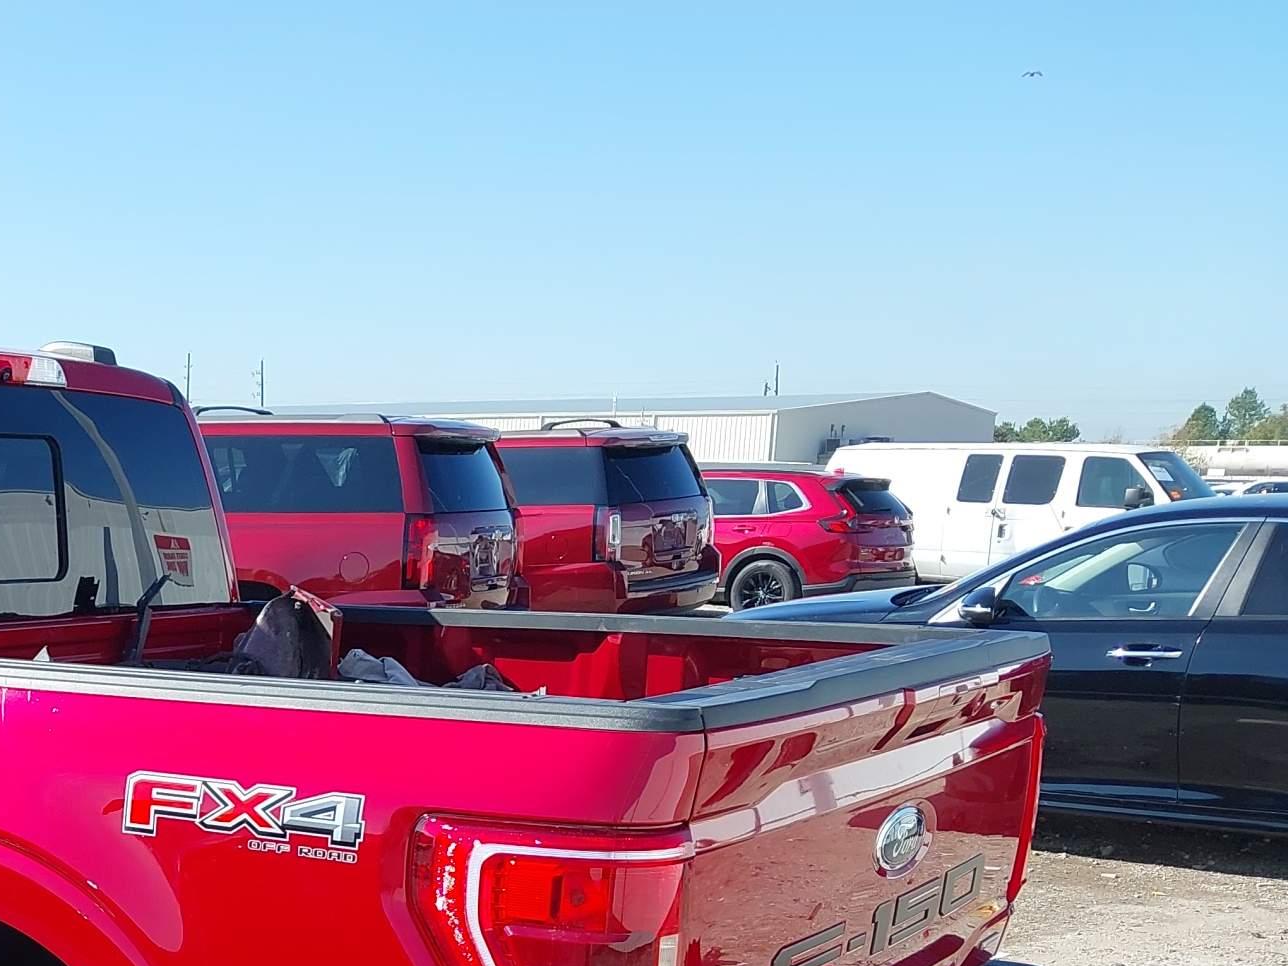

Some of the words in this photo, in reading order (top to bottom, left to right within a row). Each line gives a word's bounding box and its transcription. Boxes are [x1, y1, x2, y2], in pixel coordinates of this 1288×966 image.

[122, 770, 366, 850] FX4
[247, 839, 291, 854] OFF
[297, 845, 358, 864] ROAD
[891, 815, 920, 858] Ford
